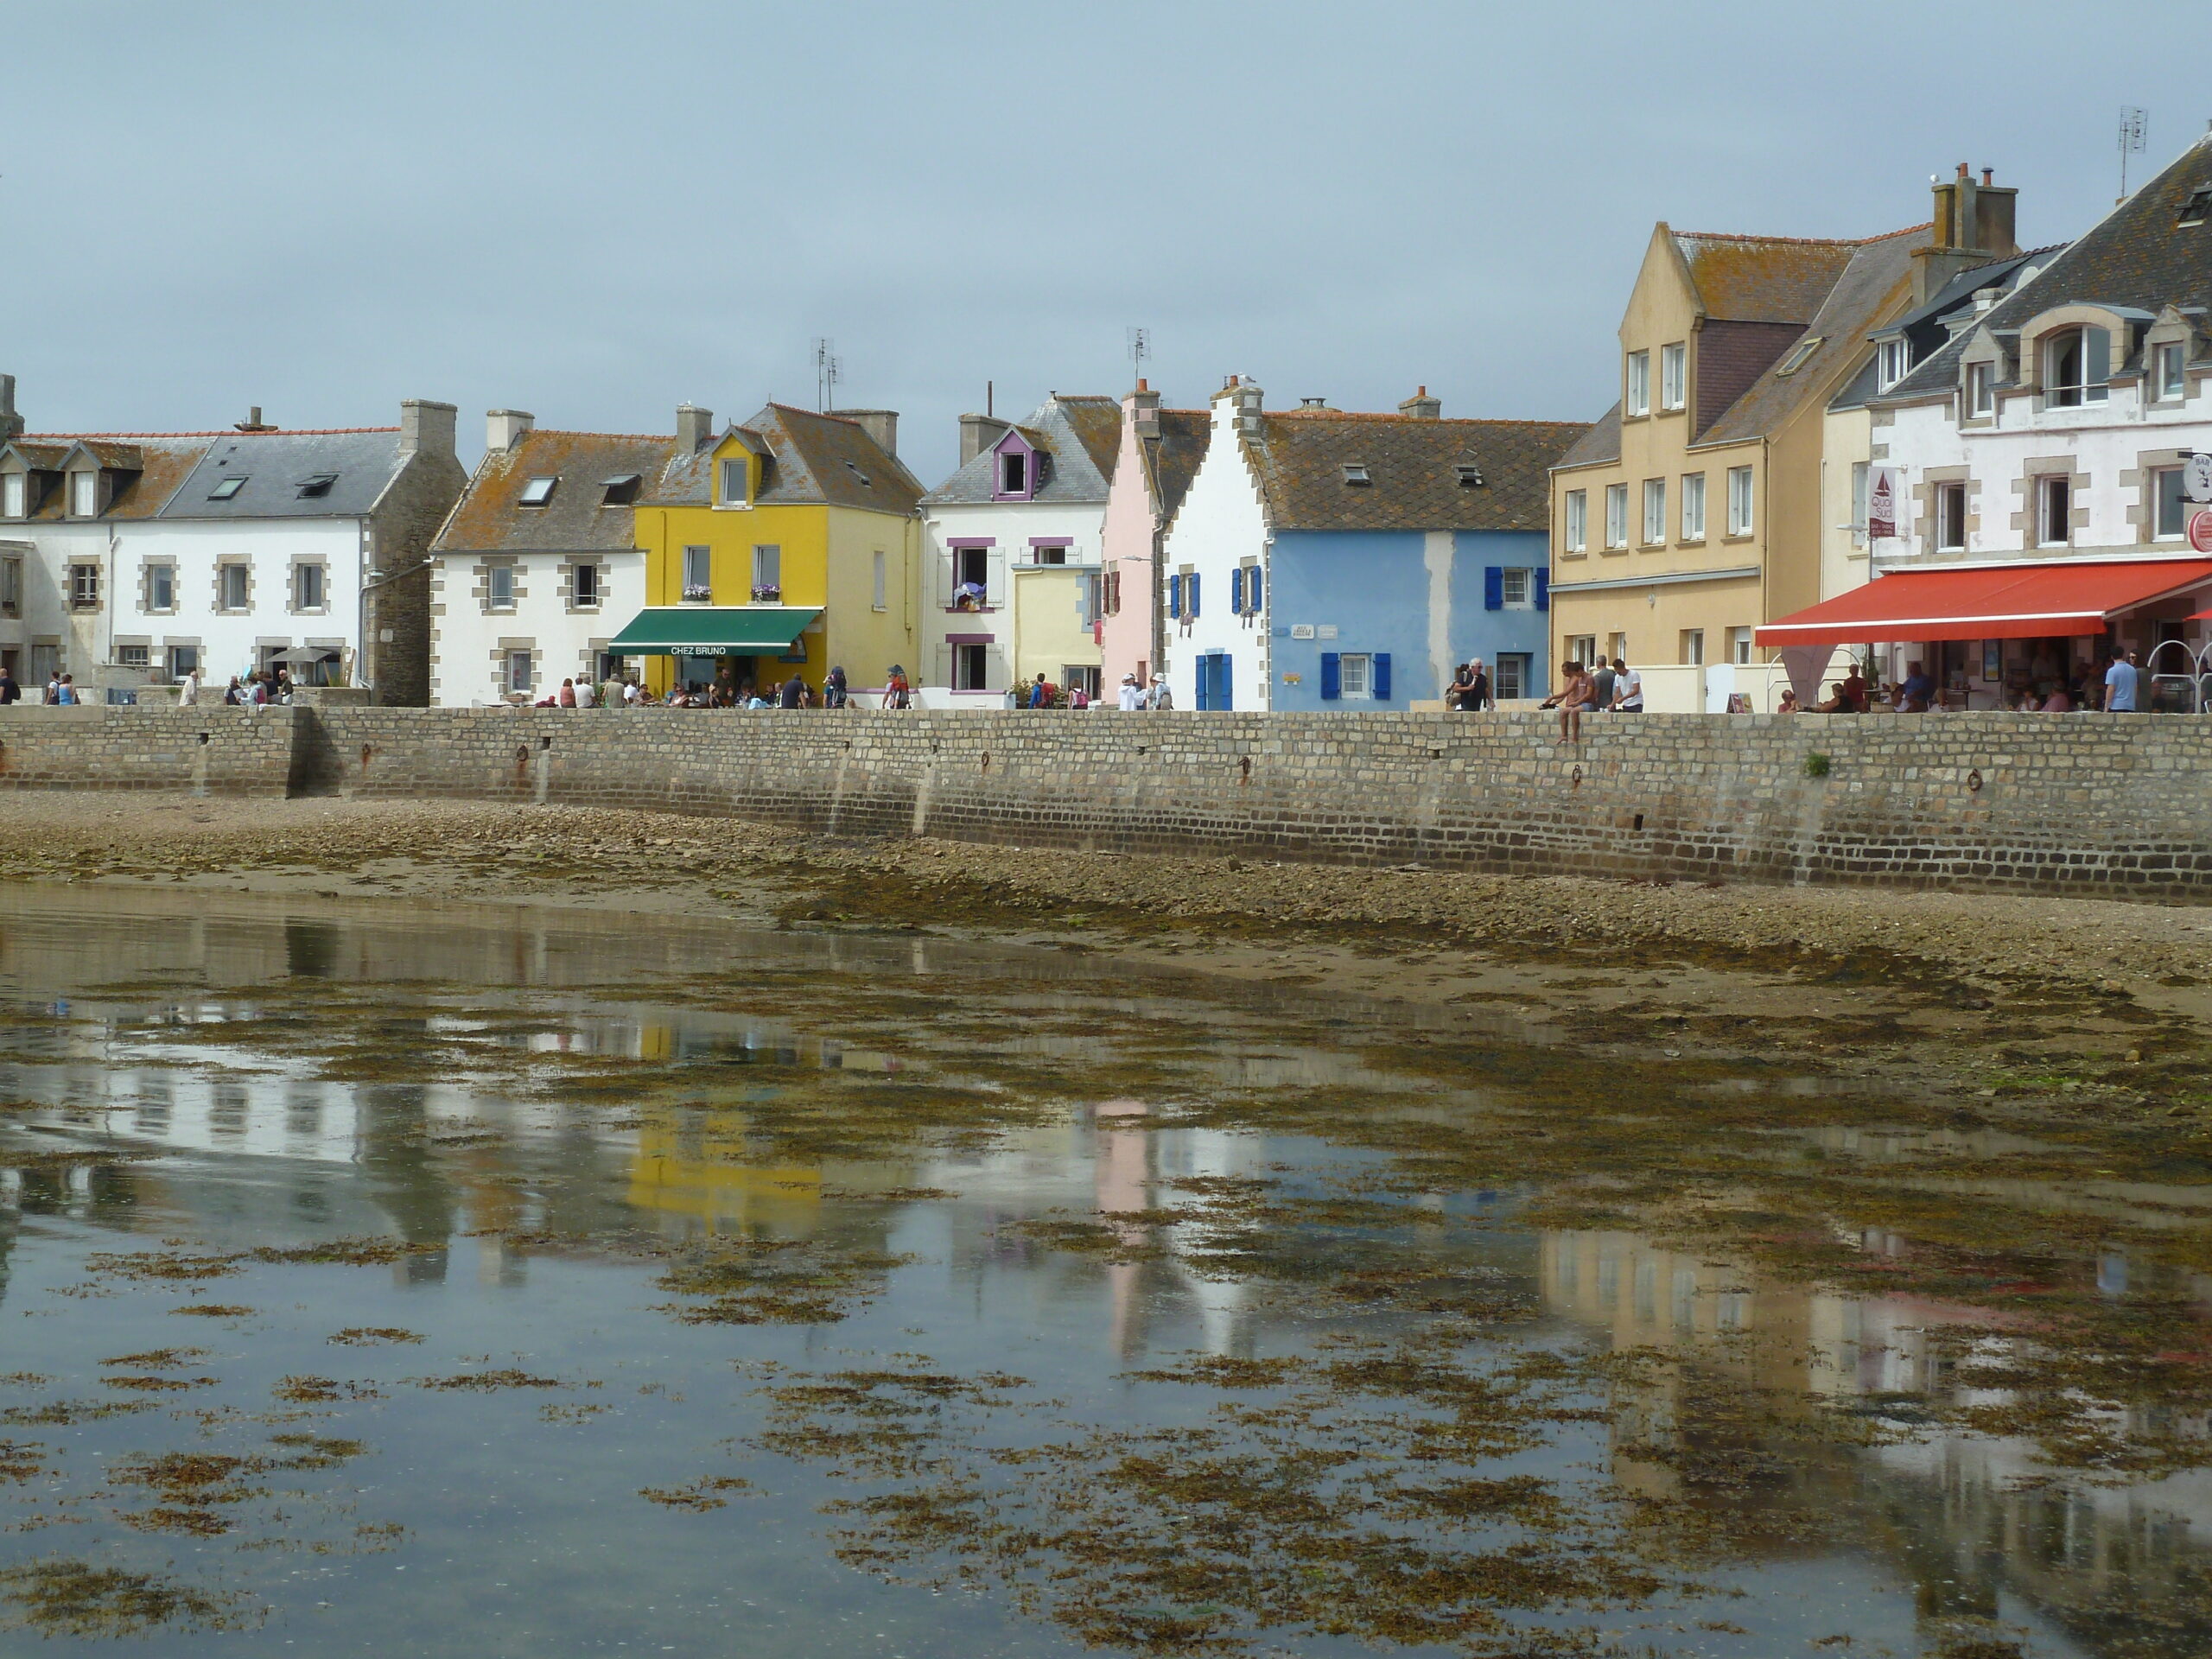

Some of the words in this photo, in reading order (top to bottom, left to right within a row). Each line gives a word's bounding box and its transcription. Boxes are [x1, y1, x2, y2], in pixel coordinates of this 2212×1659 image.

[2195, 458, 2210, 467] BAR
[1872, 496, 1892, 507] Quai
[1876, 507, 1892, 518] Sud
[671, 646, 694, 655] CHEZ
[696, 646, 726, 655] BRUNO
